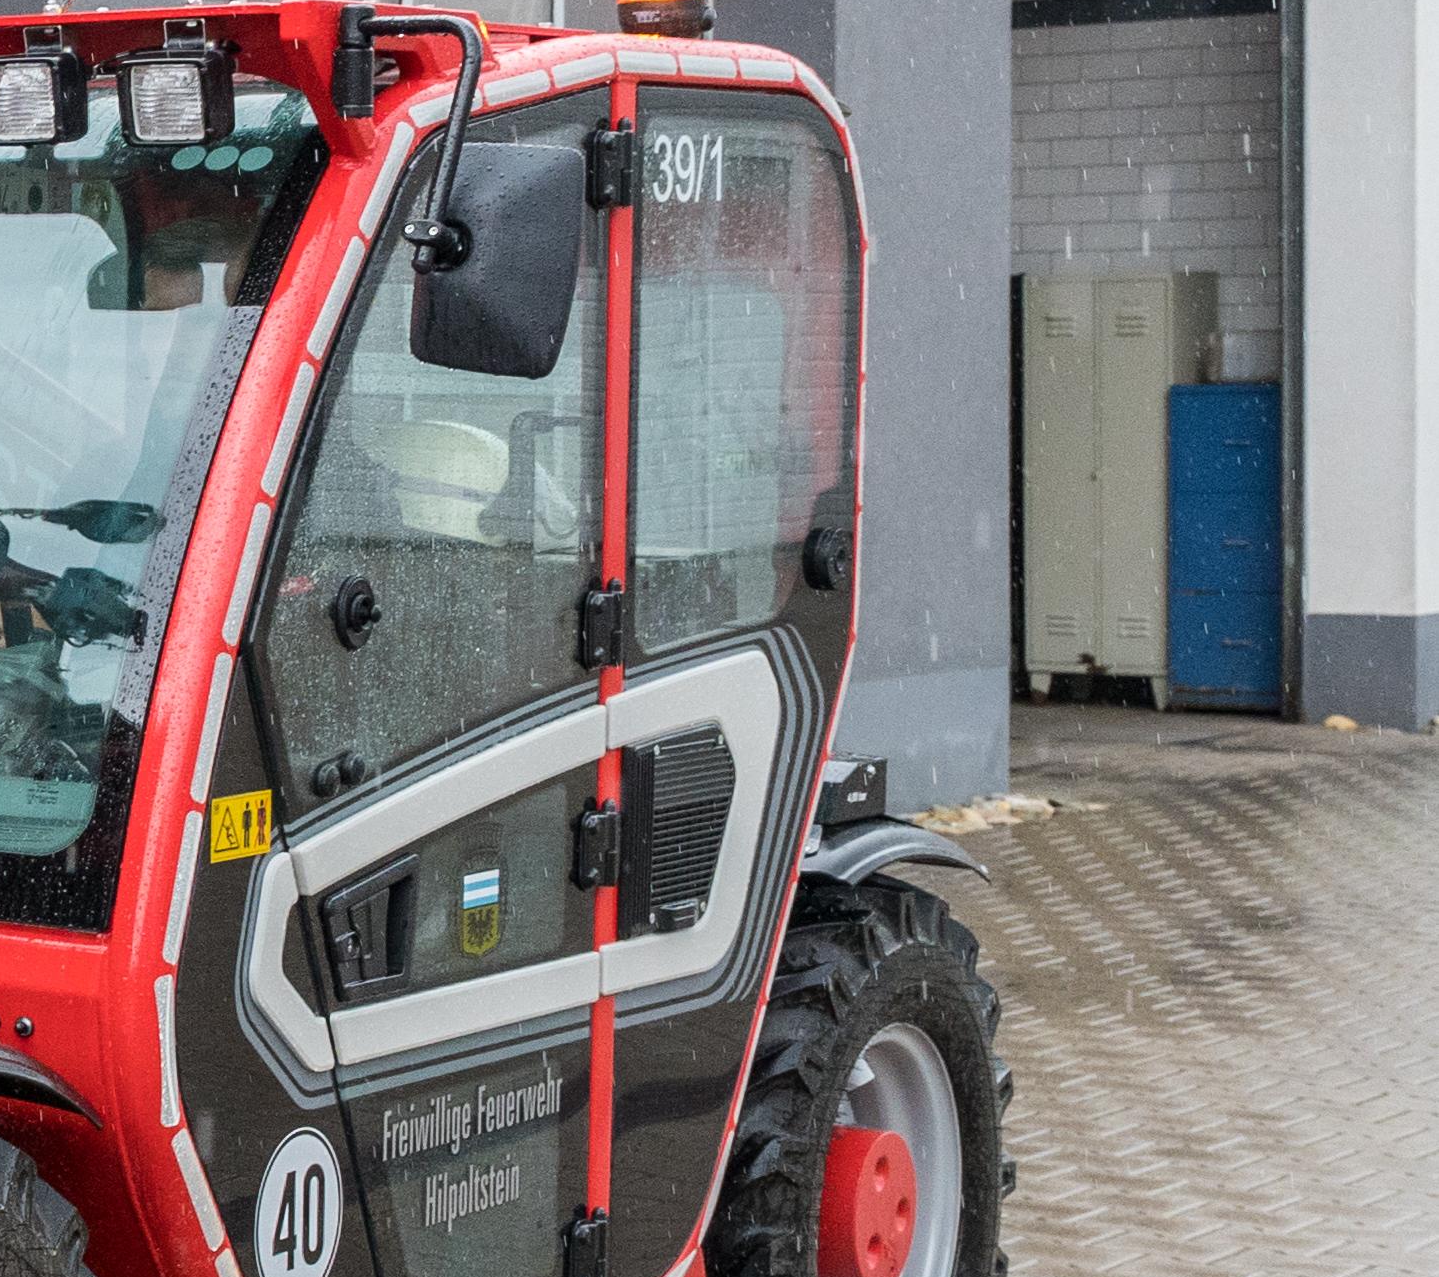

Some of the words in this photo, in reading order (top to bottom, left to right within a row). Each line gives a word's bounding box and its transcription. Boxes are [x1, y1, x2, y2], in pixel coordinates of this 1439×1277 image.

[651, 133, 723, 203] 39/1
[382, 1094, 471, 1161] Freiwillige
[477, 1068, 563, 1135] Feuerwehr
[271, 1162, 326, 1272] 40
[425, 1154, 520, 1233] Hilpoltstein
